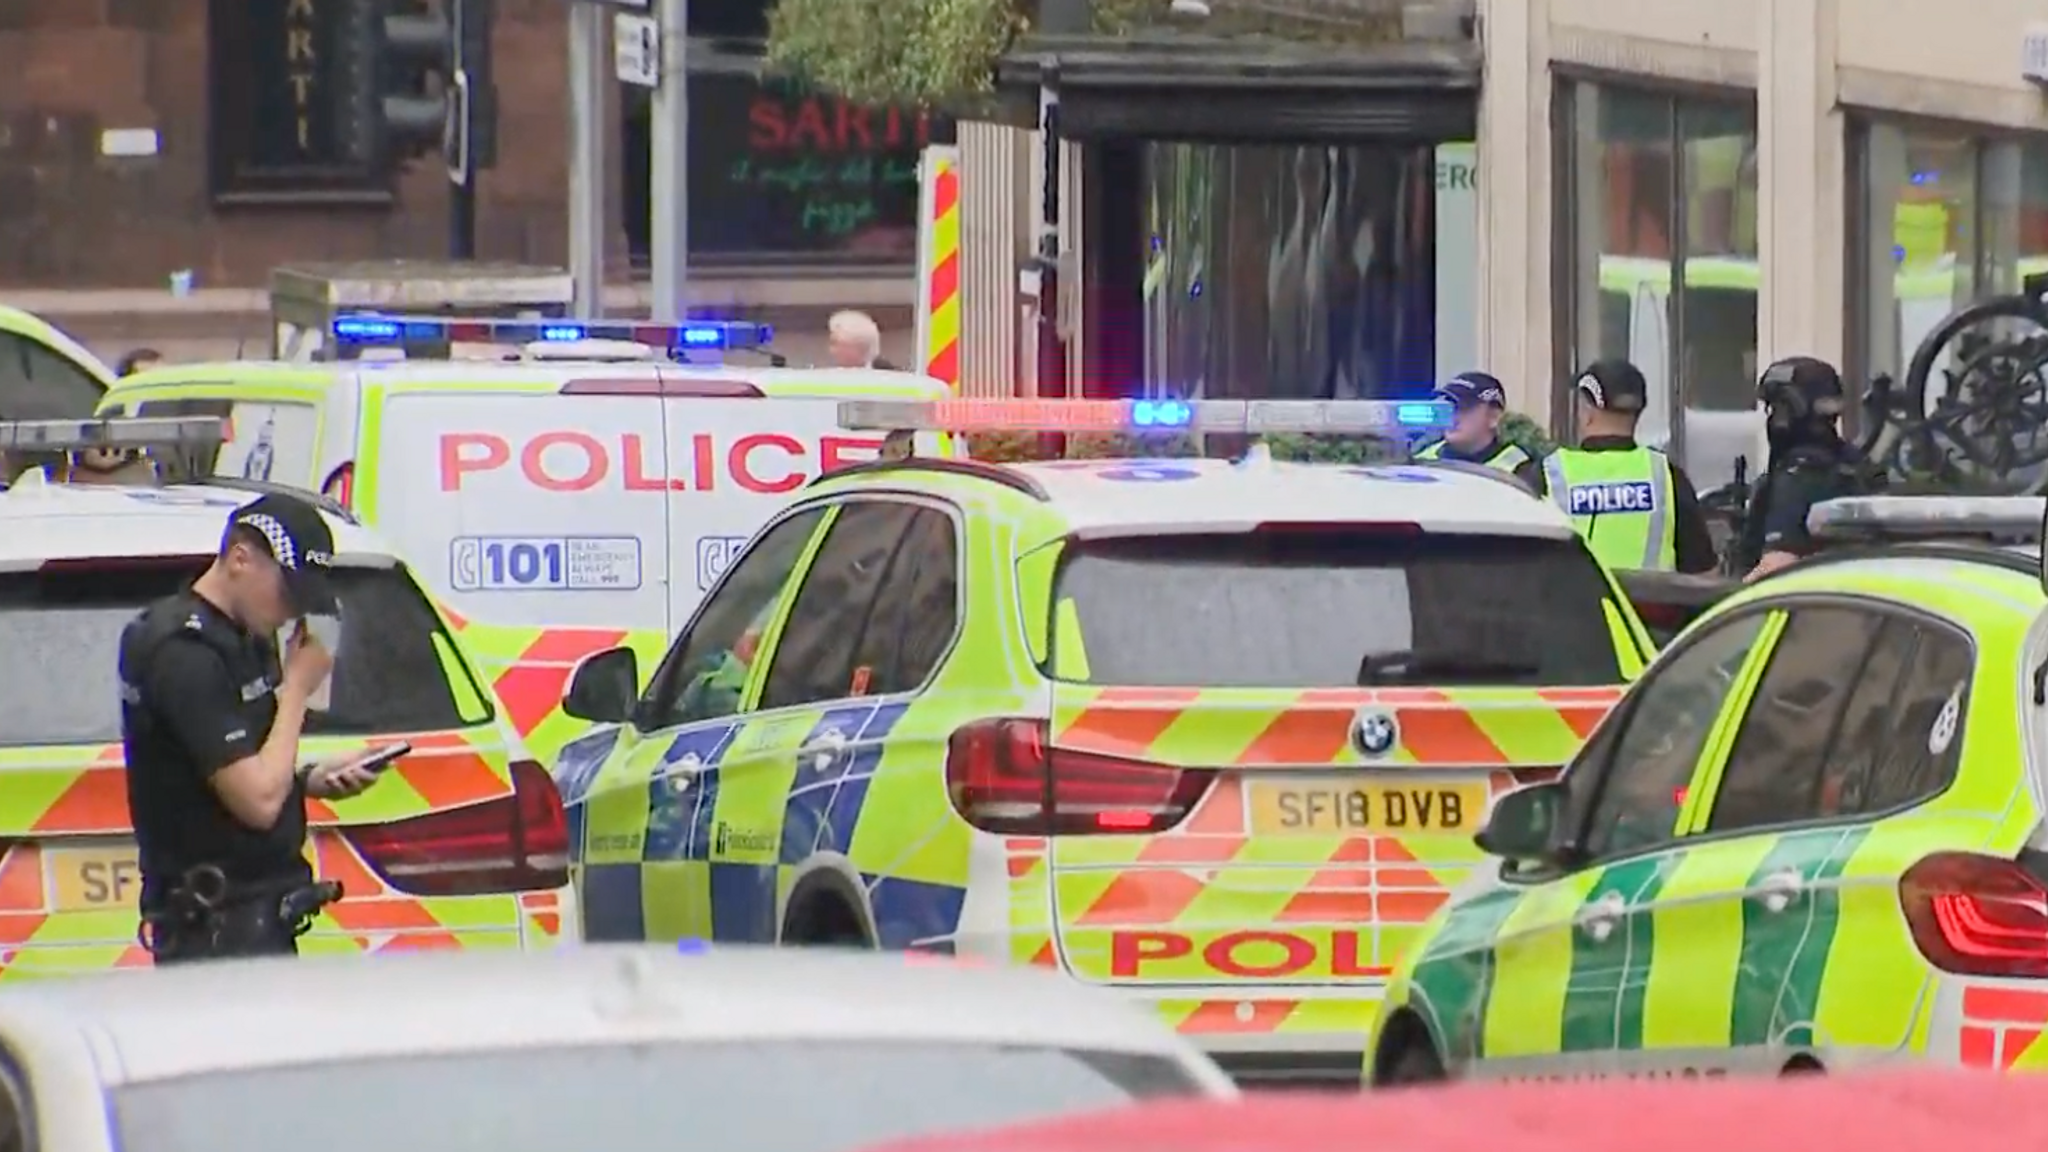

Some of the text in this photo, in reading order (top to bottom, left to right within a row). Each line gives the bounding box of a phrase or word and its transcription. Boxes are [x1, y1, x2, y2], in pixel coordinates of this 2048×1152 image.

[440, 432, 884, 494] POLICE
[1571, 484, 1652, 511] POLICE
[486, 543, 560, 584] 101
[1278, 790, 1463, 828] SF18 DVB
[1110, 930, 1394, 978] POL
